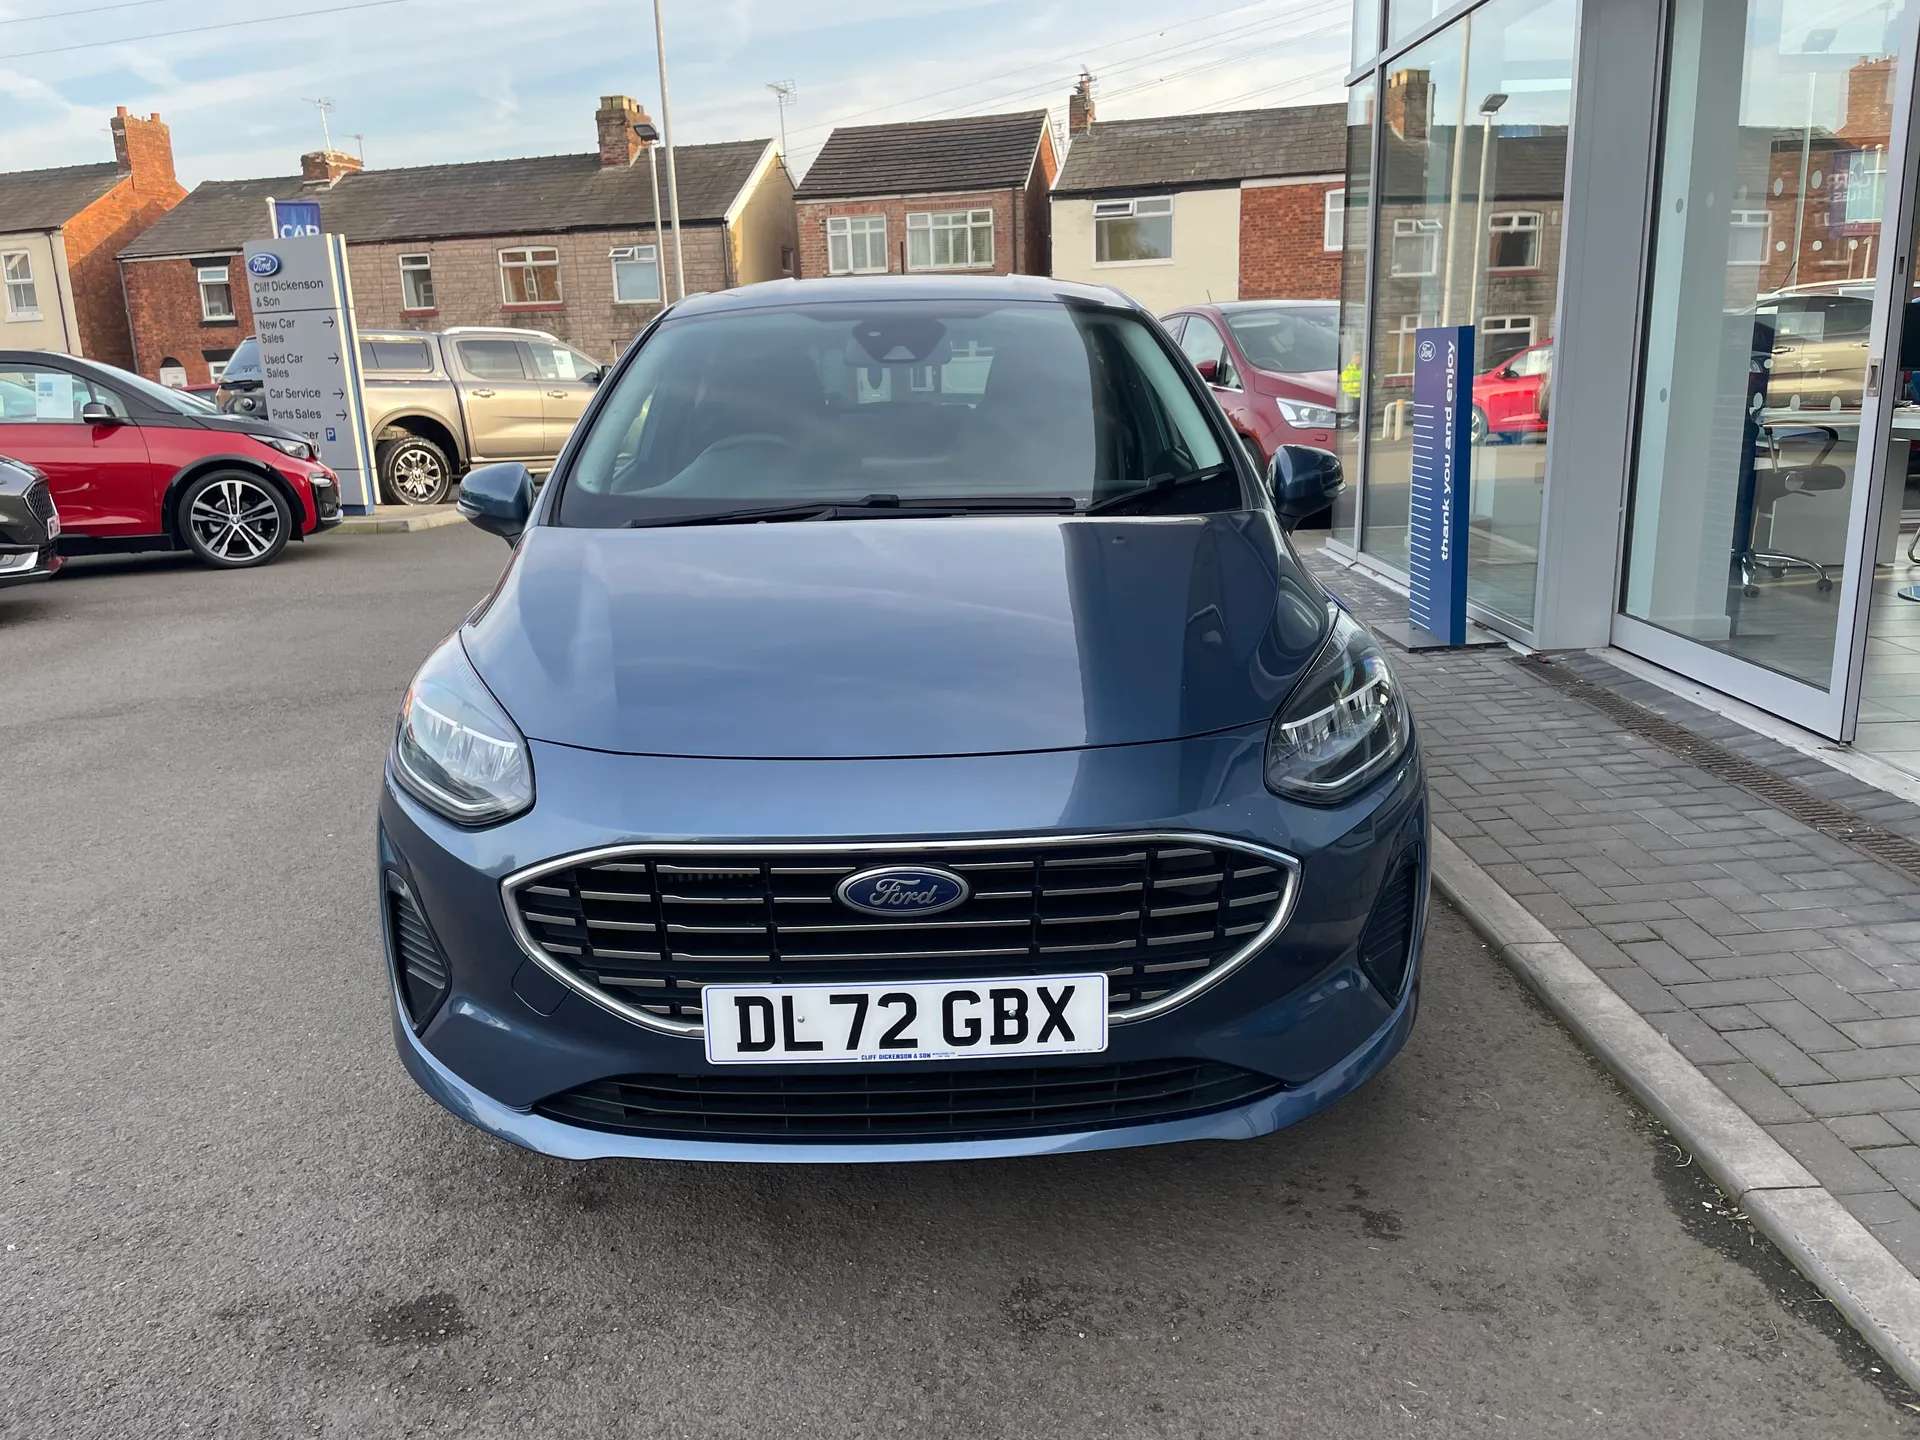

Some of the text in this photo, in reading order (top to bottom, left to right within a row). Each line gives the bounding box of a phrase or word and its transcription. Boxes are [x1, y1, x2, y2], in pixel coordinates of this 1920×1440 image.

[254, 280, 324, 293] Cliff Dickenson
[256, 296, 280, 307] & Son
[260, 318, 295, 329] New Car
[261, 332, 285, 344] Sales
[264, 353, 303, 364] Used Car
[266, 367, 290, 378] Sales
[269, 387, 321, 399] Car Service
[272, 408, 322, 419] Parts Sales
[1441, 340, 1456, 561] thank you and enjoy
[869, 877, 939, 906] Ford
[942, 985, 1076, 1047] GBX
